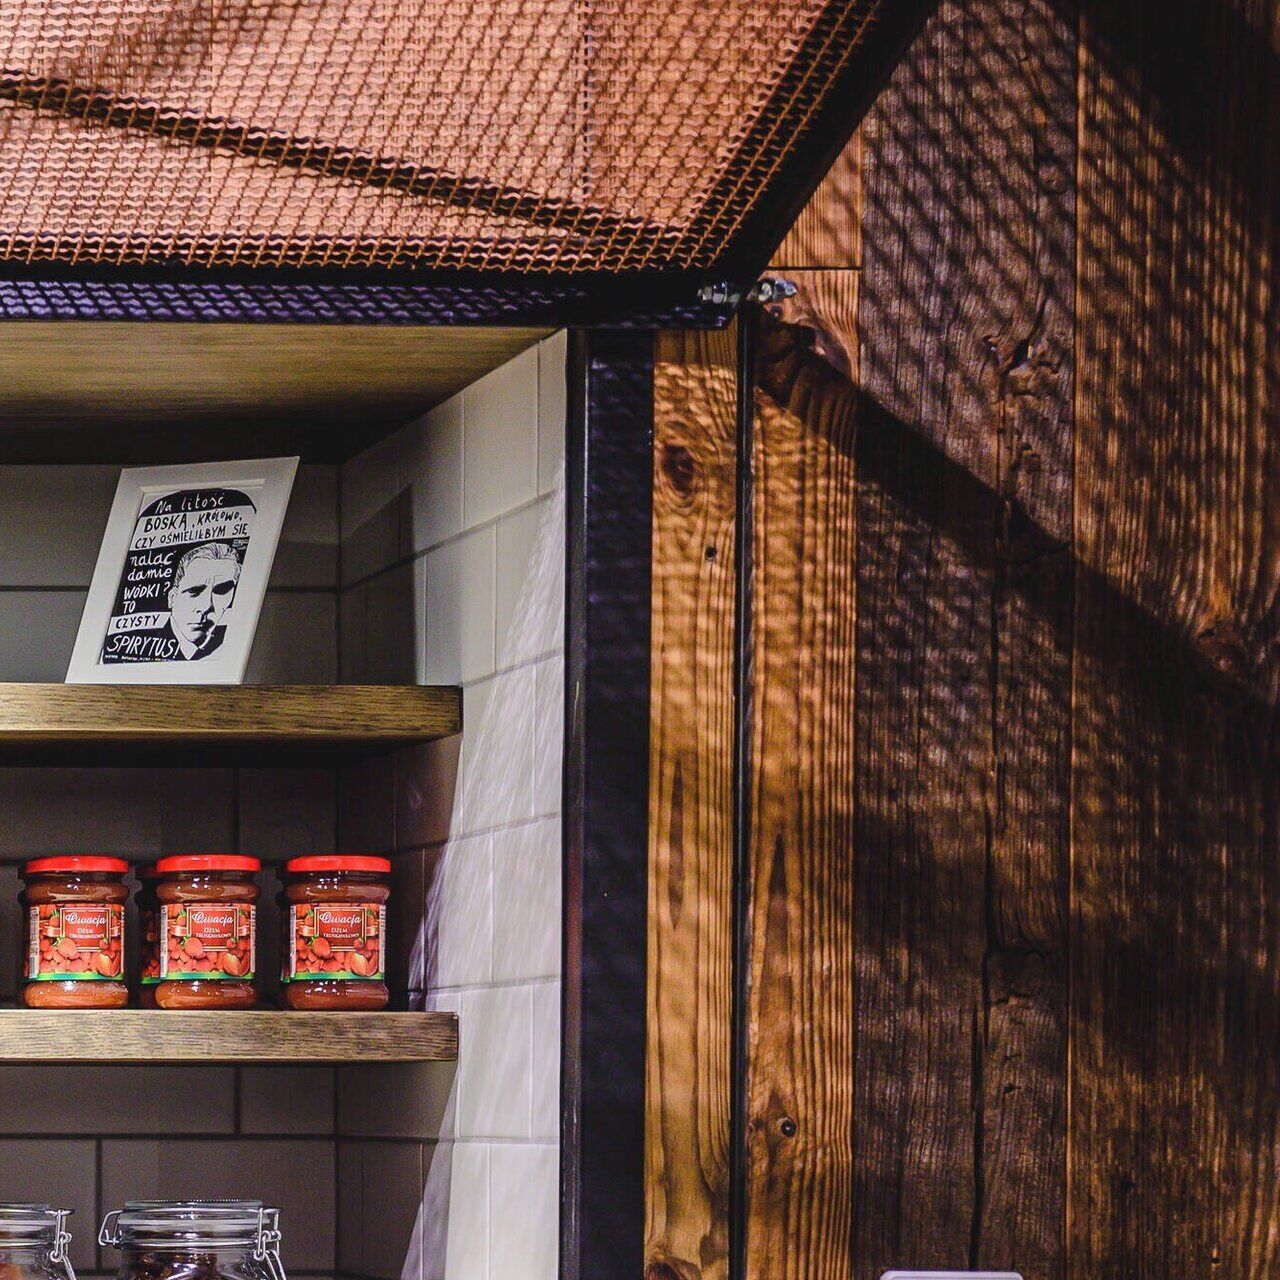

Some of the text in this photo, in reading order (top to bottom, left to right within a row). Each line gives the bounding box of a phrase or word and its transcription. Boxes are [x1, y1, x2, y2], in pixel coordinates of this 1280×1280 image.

[155, 500, 172, 514] Na
[134, 536, 156, 549] CZY
[129, 550, 178, 567] nalać
[127, 564, 173, 582] damie
[122, 600, 137, 614] TO
[115, 614, 160, 629] CZYSTY
[106, 635, 180, 659] SPIRYTUS!
[65, 912, 107, 927] Owacja
[191, 912, 234, 927] Owacja
[319, 912, 362, 927] Owacja
